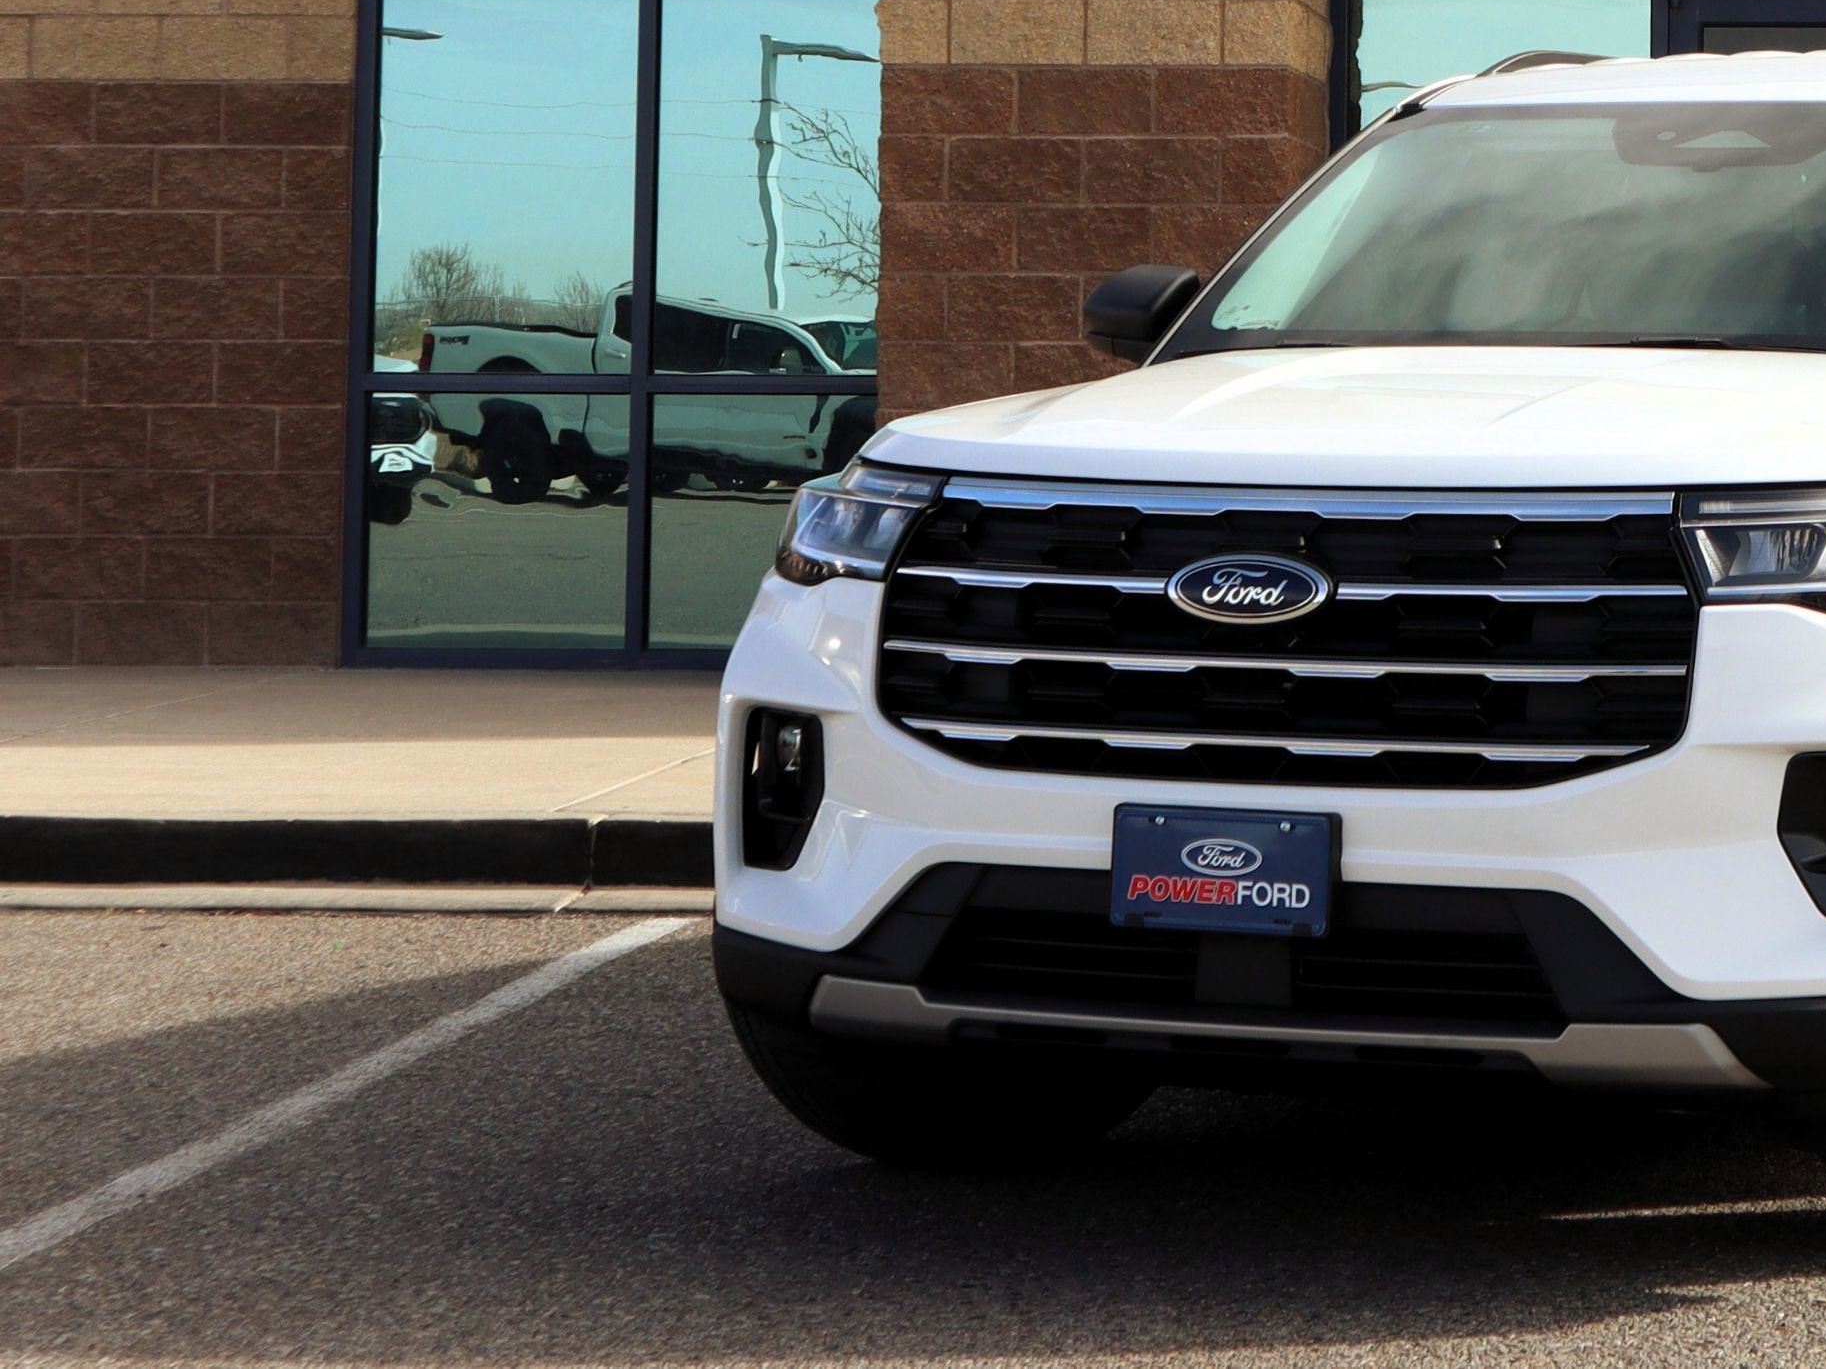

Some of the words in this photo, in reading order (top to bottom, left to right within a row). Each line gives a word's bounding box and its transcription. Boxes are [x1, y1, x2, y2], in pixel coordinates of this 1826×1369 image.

[1202, 568, 1289, 606] Ford
[1197, 844, 1245, 869] Ford
[1127, 874, 1311, 909] POWERFORD
